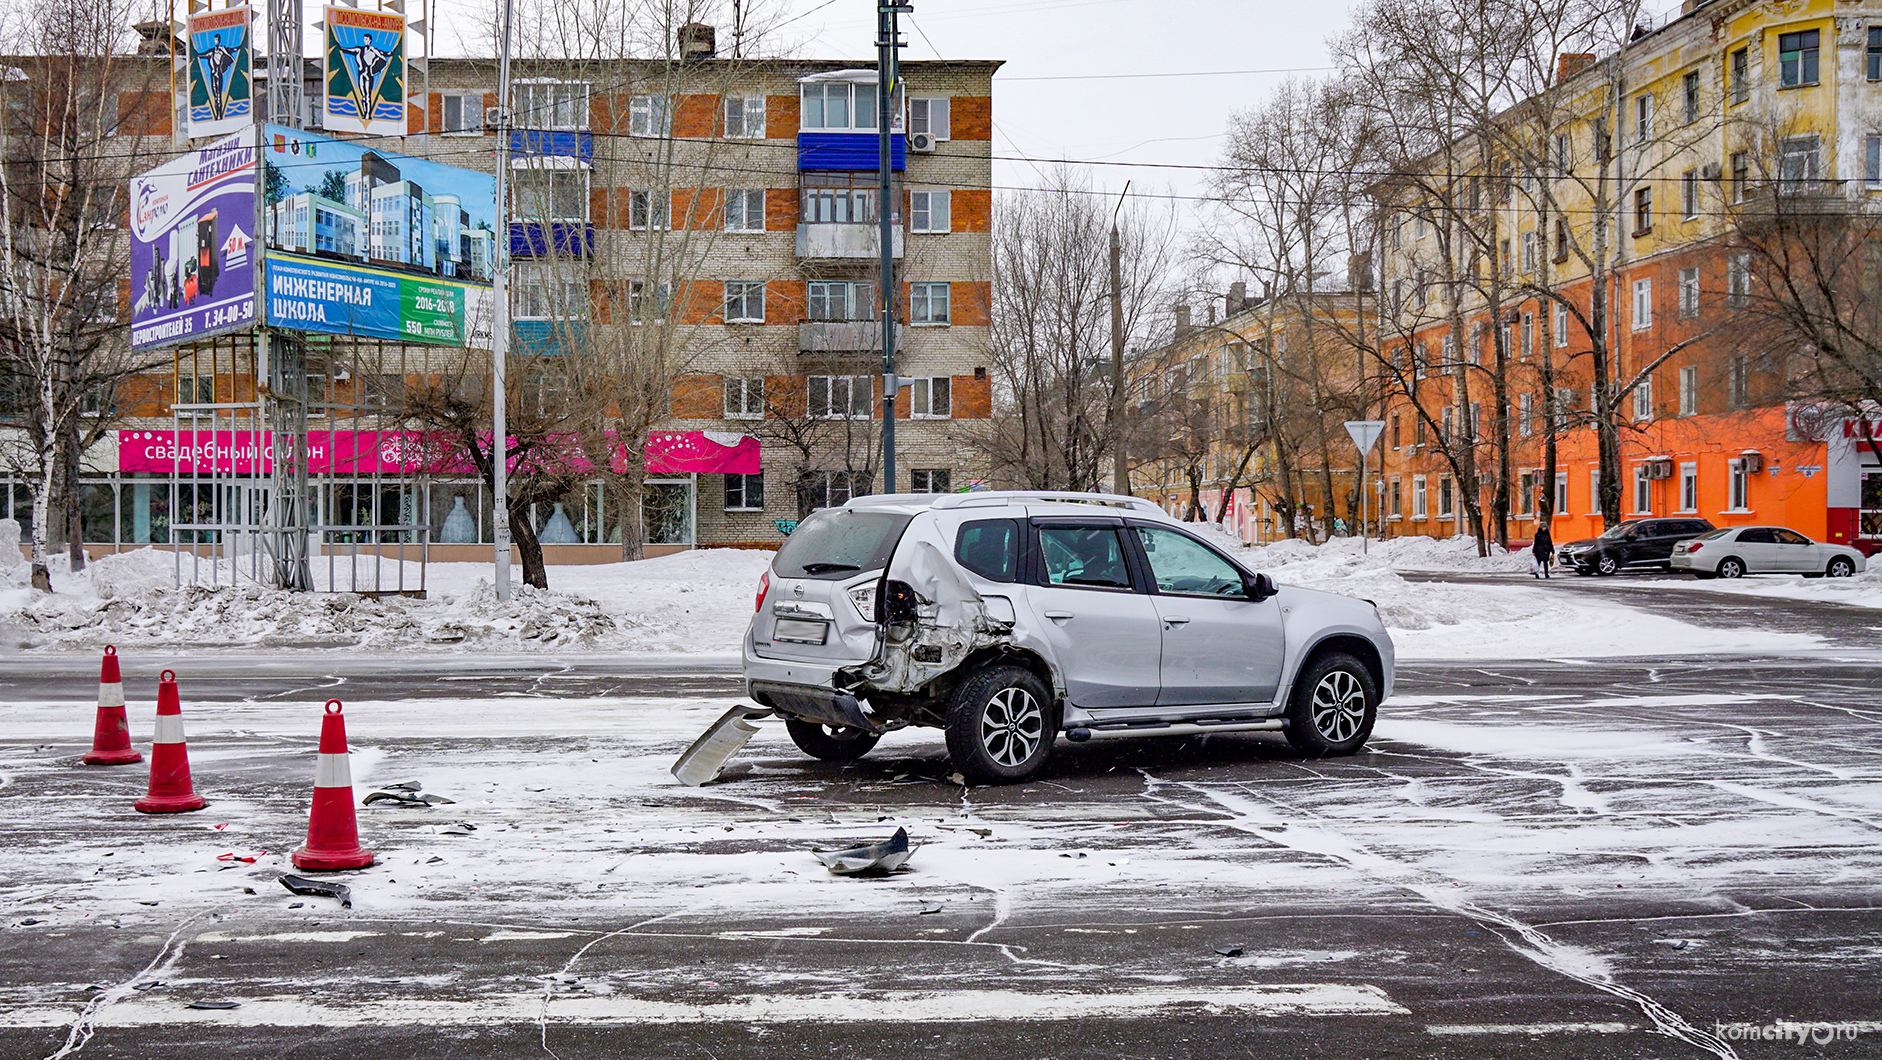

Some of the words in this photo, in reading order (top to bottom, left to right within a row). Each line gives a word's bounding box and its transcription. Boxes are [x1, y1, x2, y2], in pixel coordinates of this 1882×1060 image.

[187, 147, 252, 187] САНТЕХНИКИ
[228, 237, 236, 254] 50
[273, 274, 372, 307] ИНЖЕНЕРНАЯ
[273, 298, 327, 323] ШКОЛА
[184, 317, 193, 333] 35
[406, 320, 422, 335] 550
[145, 441, 259, 463] свадебный
